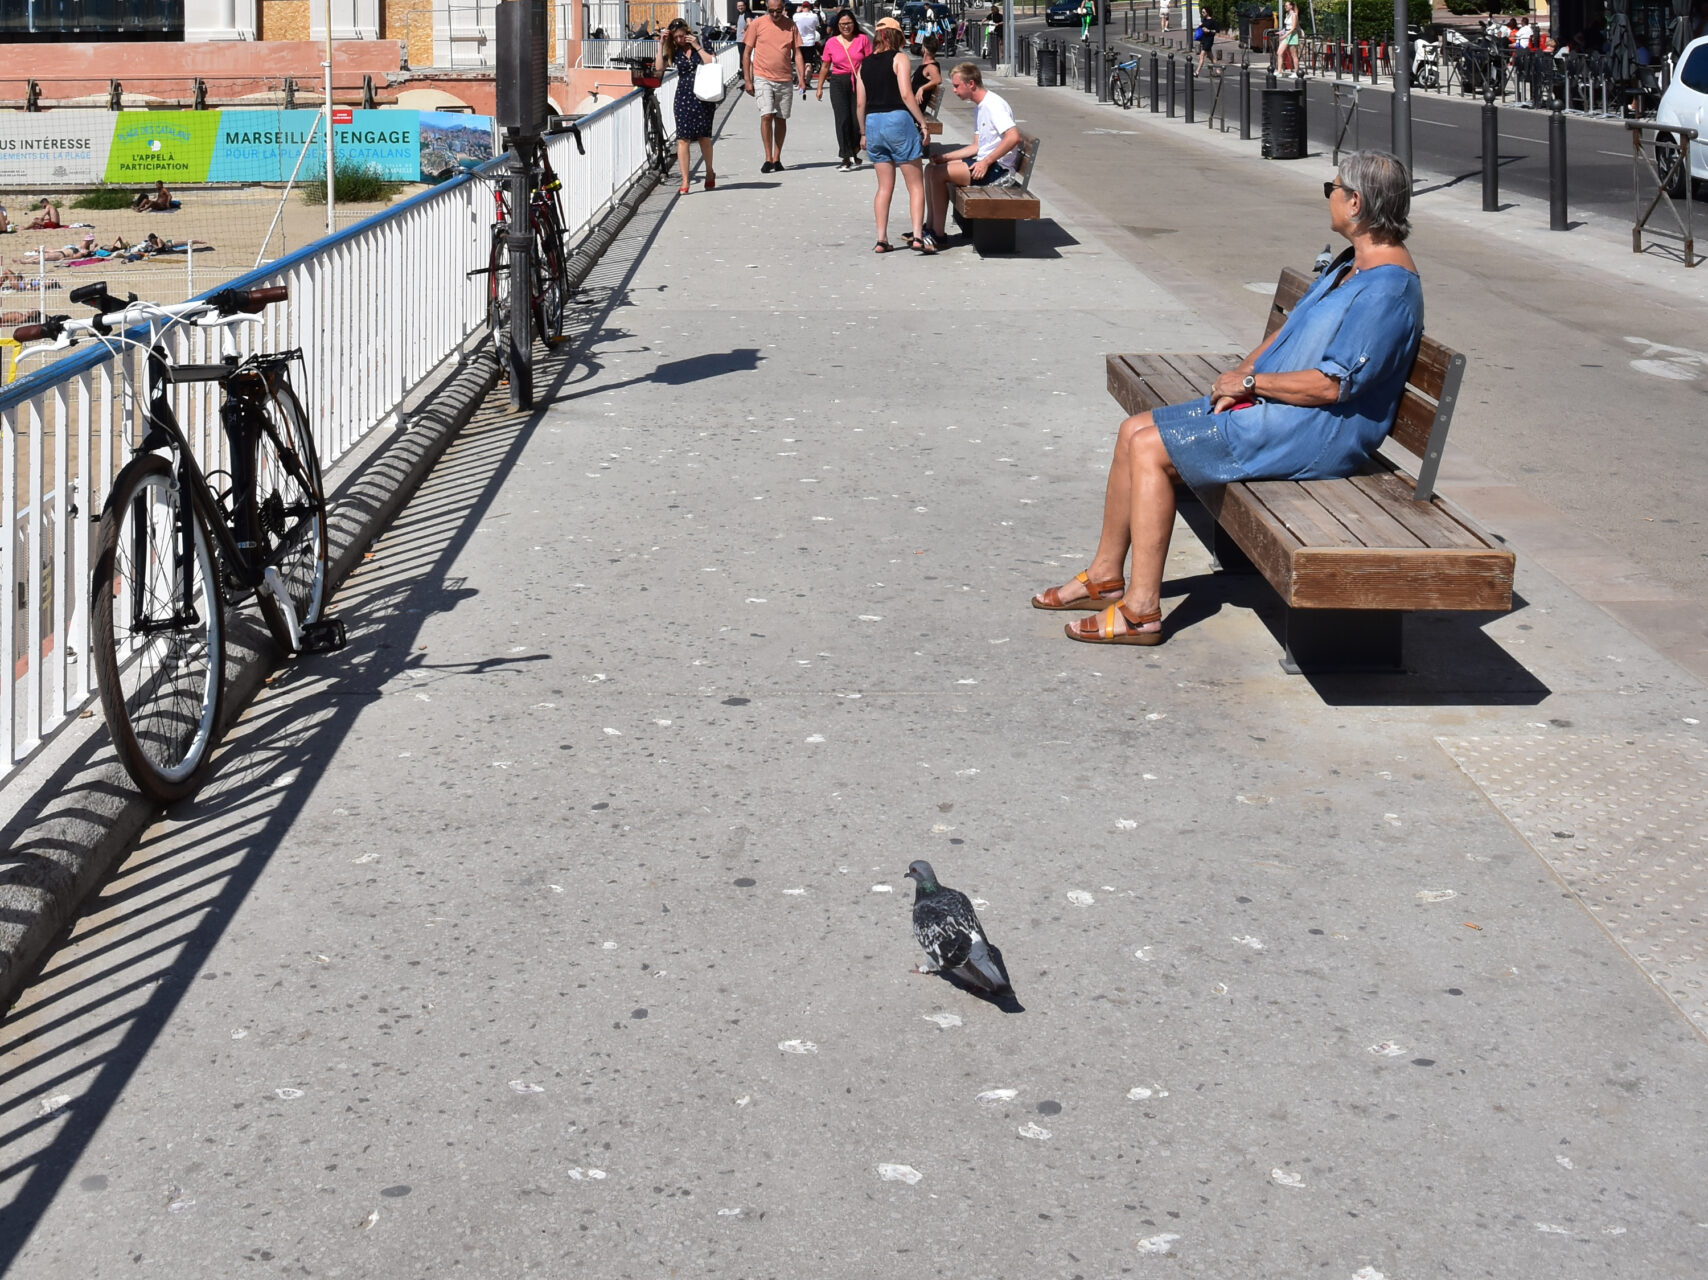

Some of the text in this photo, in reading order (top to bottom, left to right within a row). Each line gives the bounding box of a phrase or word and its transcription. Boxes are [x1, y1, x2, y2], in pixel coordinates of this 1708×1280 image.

[21, 136, 91, 149] INTÉRESSE
[226, 132, 318, 144] MARSEILLE
[40, 152, 49, 160] DE
[53, 152, 63, 160] LA
[65, 152, 91, 160] PLAGE
[132, 152, 175, 162] L'APPEL À
[226, 148, 258, 159] POUR
[263, 148, 277, 159] LA
[350, 148, 411, 158] CATALANS
[120, 163, 189, 171] PARTICIPATION
